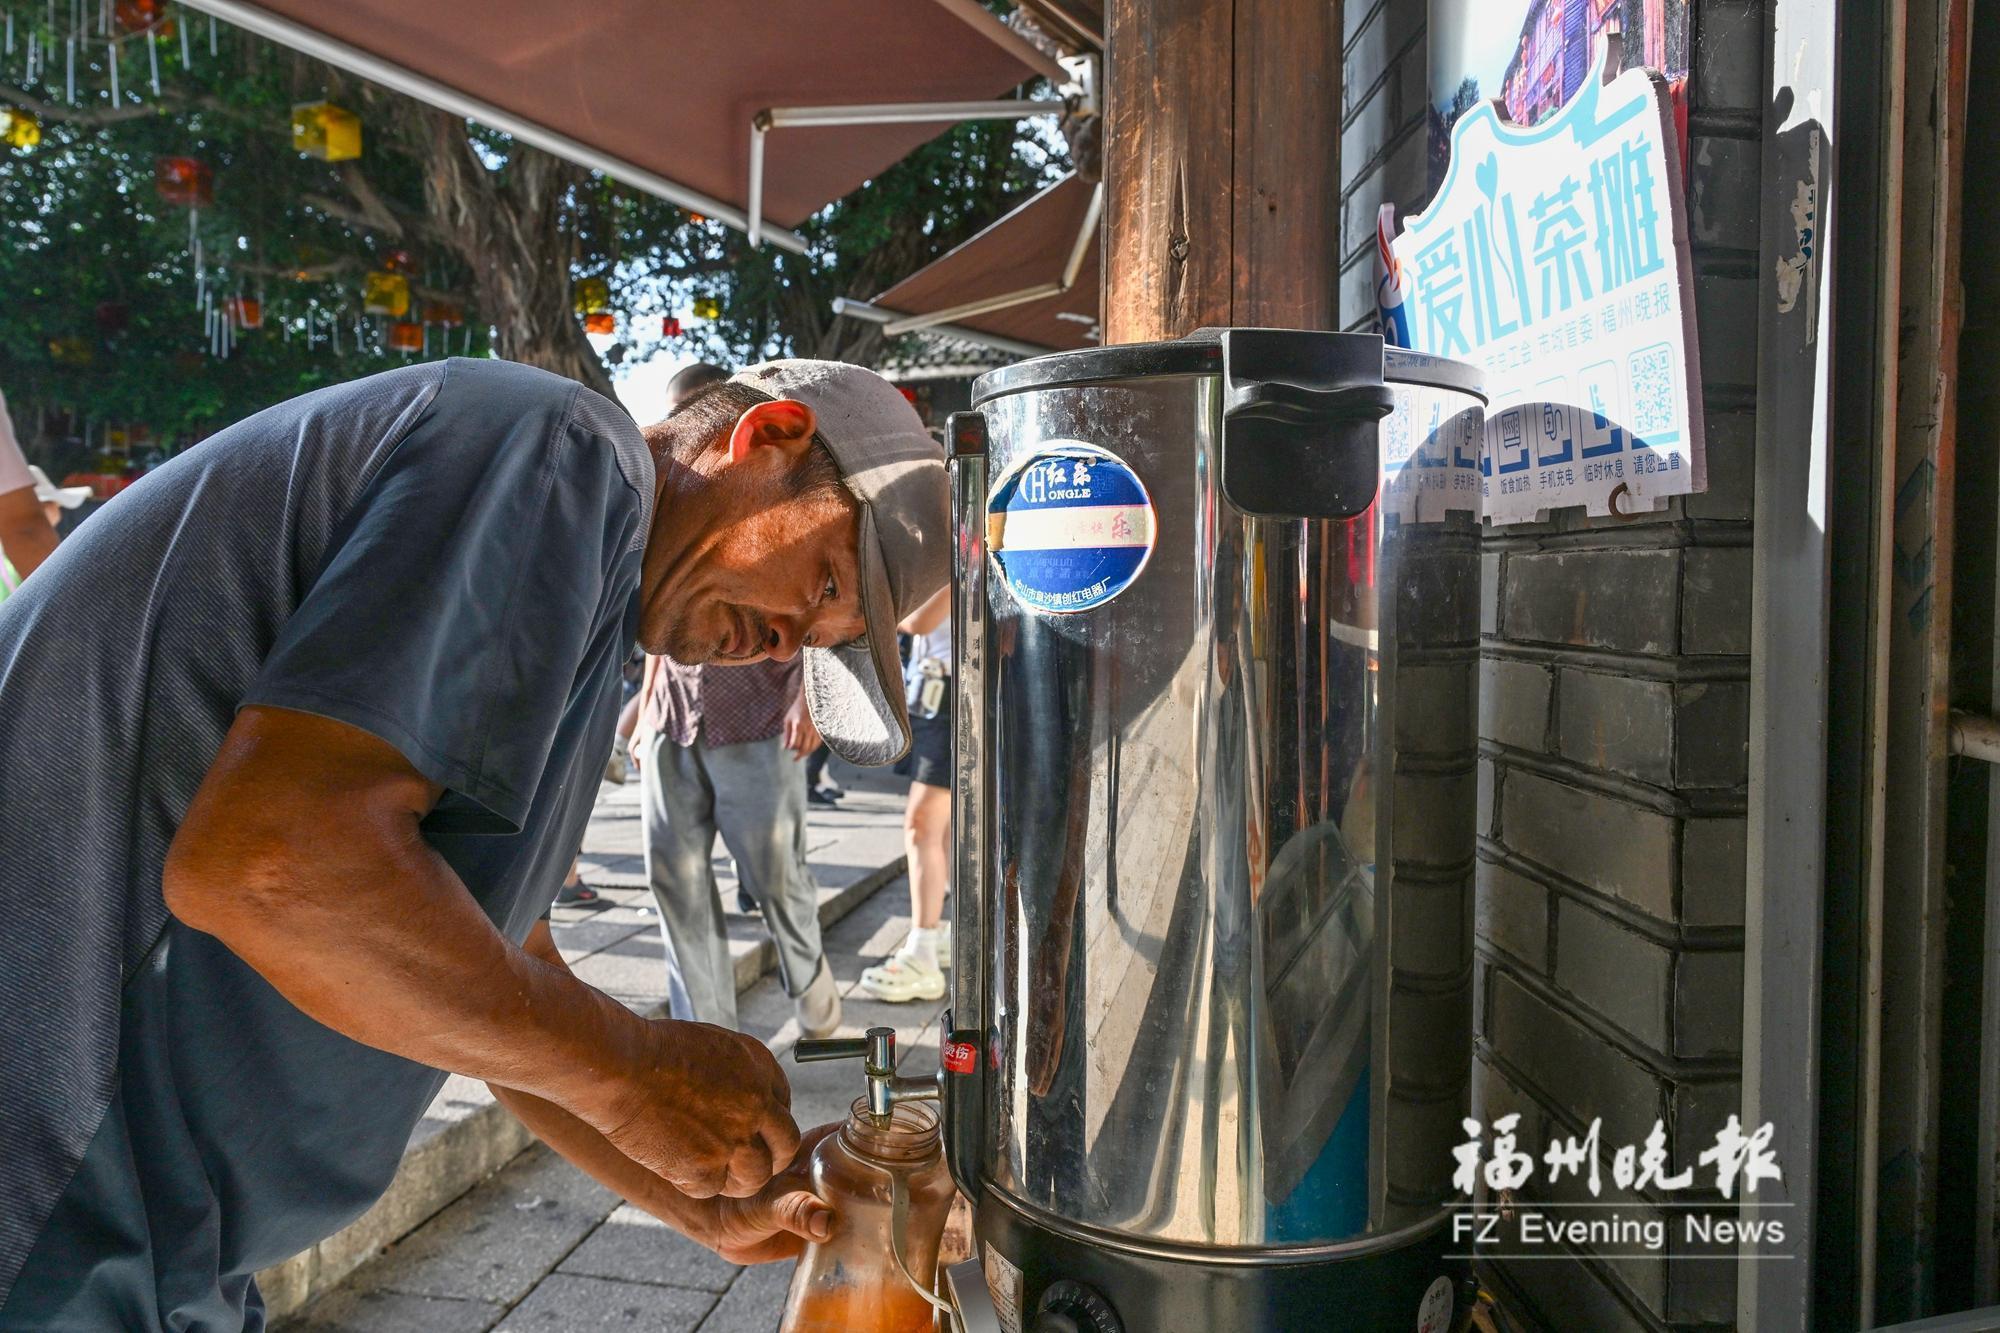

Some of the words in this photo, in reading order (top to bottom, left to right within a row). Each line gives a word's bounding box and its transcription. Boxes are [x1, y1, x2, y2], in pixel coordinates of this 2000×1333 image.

[1413, 131, 1665, 358] 爱心茶摊
[1601, 282, 1672, 334] 福州晚报
[1539, 468, 1575, 490] 手机充电
[1584, 459, 1625, 483] 临时休息
[1633, 452, 1681, 476] 请您监督
